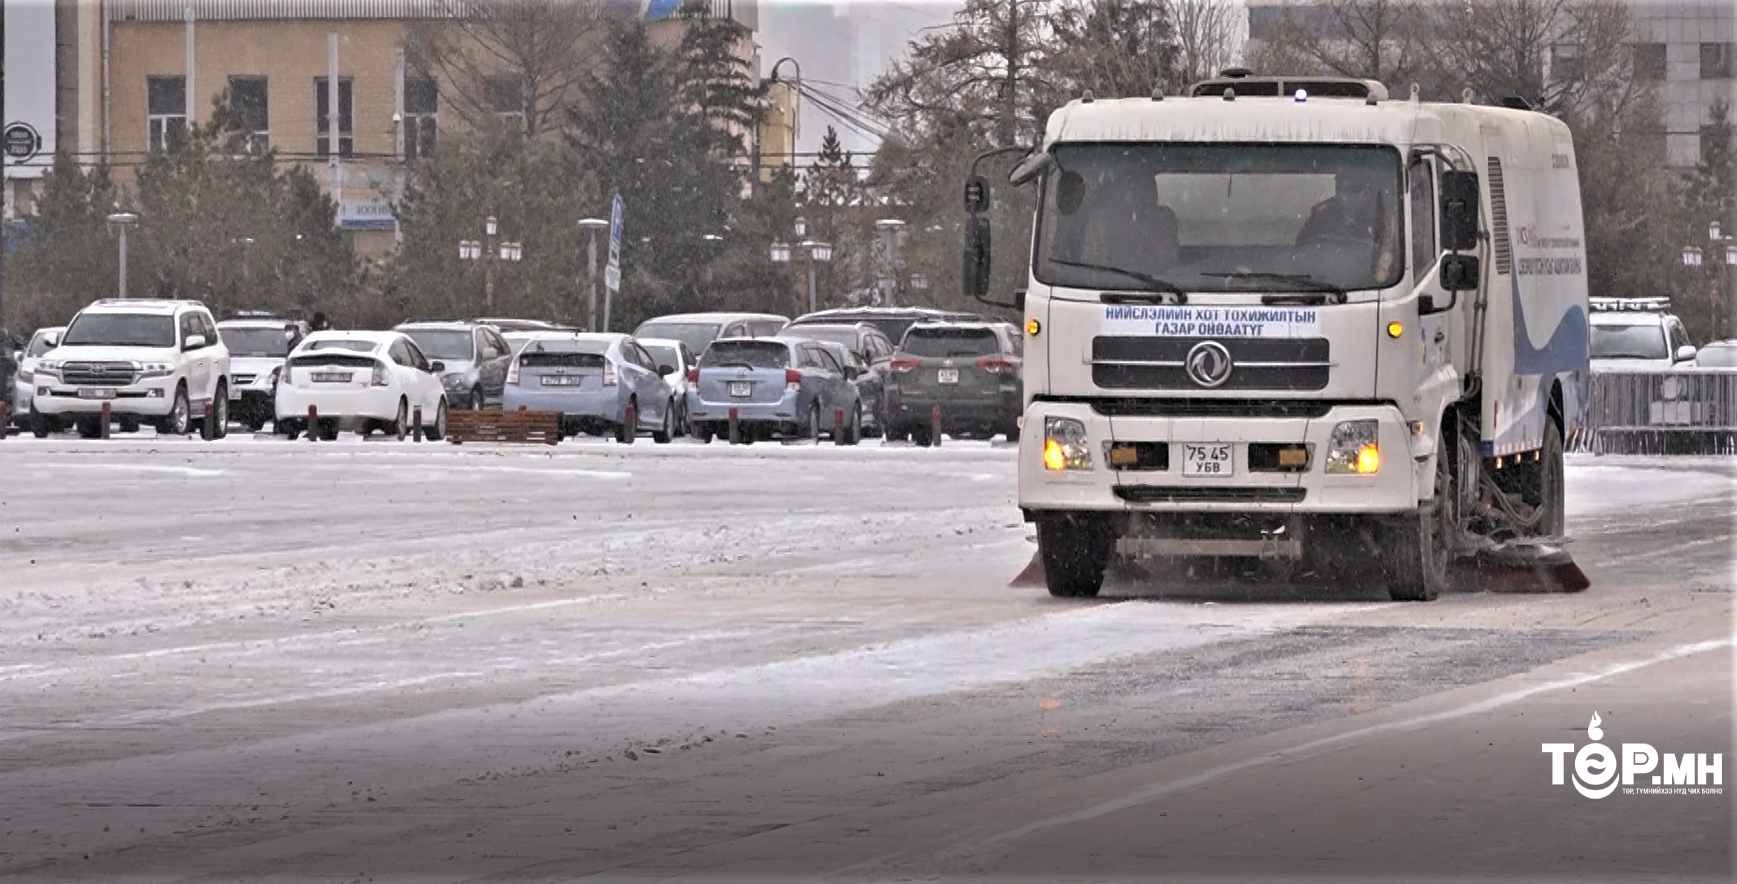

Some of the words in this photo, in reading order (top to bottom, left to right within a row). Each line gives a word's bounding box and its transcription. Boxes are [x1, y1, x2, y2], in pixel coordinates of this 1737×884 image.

[1105, 306, 1192, 320] НИЙСЛЭЛИЙН
[1195, 309, 1220, 321] ХОТ
[1224, 310, 1316, 323] ТОХИЖИЛТЫН
[1155, 323, 1195, 335] ГАЗАР
[1187, 446, 1206, 461] 75
[1211, 446, 1229, 461] 45
[1196, 462, 1221, 473] УБВ
